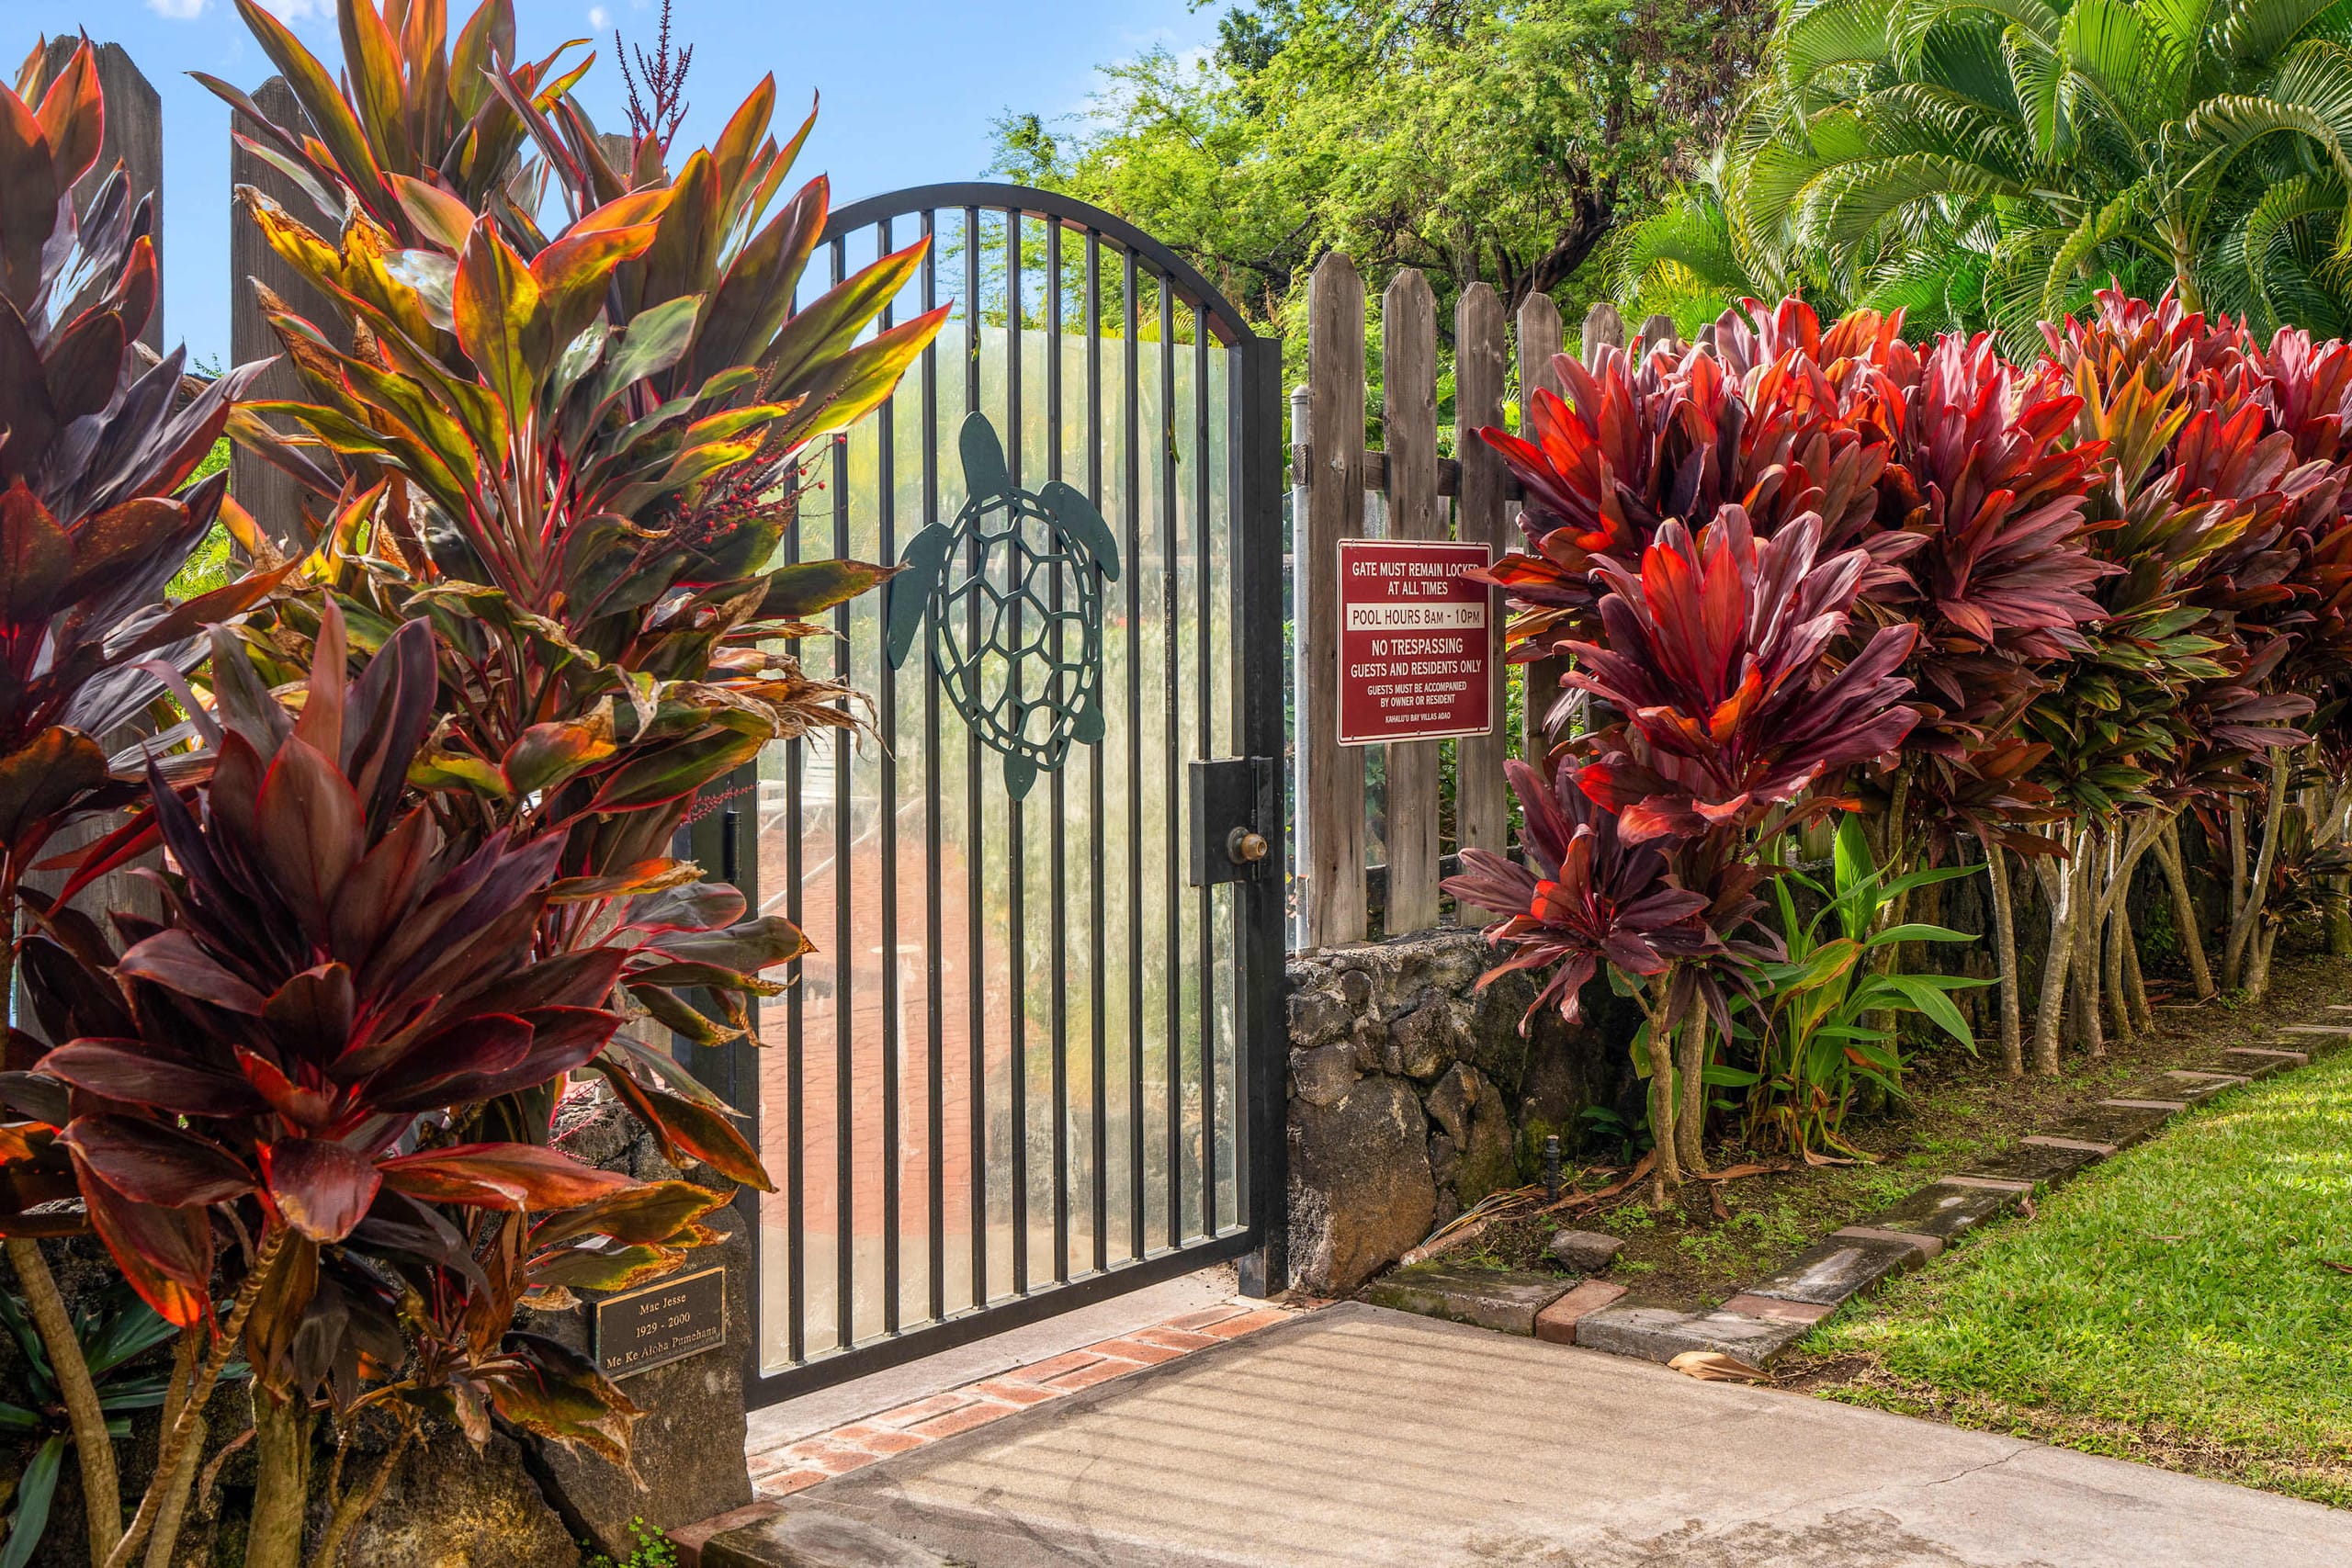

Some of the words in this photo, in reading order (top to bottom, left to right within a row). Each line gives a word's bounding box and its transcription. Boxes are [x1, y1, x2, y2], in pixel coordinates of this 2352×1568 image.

[1352, 562, 1377, 576] GATE
[1380, 563, 1407, 577] MUST
[1409, 563, 1442, 577] REMAIN
[1388, 581, 1399, 595] AT
[1402, 581, 1419, 595] ALL
[1421, 581, 1448, 594] TIMES
[1352, 610, 1382, 625] POOL
[1385, 609, 1420, 625] HOURS
[1424, 609, 1443, 624] 8AM
[1455, 609, 1480, 624] 10PM
[1372, 640, 1387, 656] NO
[1391, 638, 1464, 655] TRESPASSING
[1351, 663, 1386, 678] GUESTS
[1390, 662, 1408, 676] AND
[1411, 660, 1458, 675] RESIDENTS
[1461, 660, 1481, 673] ONLY
[1367, 685, 1394, 695] GUESTS
[1395, 683, 1413, 694] MUST
[1415, 682, 1423, 693] BE
[1424, 681, 1467, 692] ACCOMPANIED
[1381, 697, 1389, 707] BY
[1390, 696, 1414, 706] OWNER
[1415, 695, 1425, 705] OR
[1426, 694, 1455, 705] RESIDENT
[1420, 712, 1437, 720] VILLAS
[639, 1303, 660, 1315] Mac
[662, 1294, 686, 1308] Jesse
[635, 1322, 658, 1337] 1929
[668, 1312, 691, 1328] 2000
[606, 1356, 622, 1369] Me
[626, 1348, 639, 1363] Ke
[640, 1341, 669, 1359] Aloha
